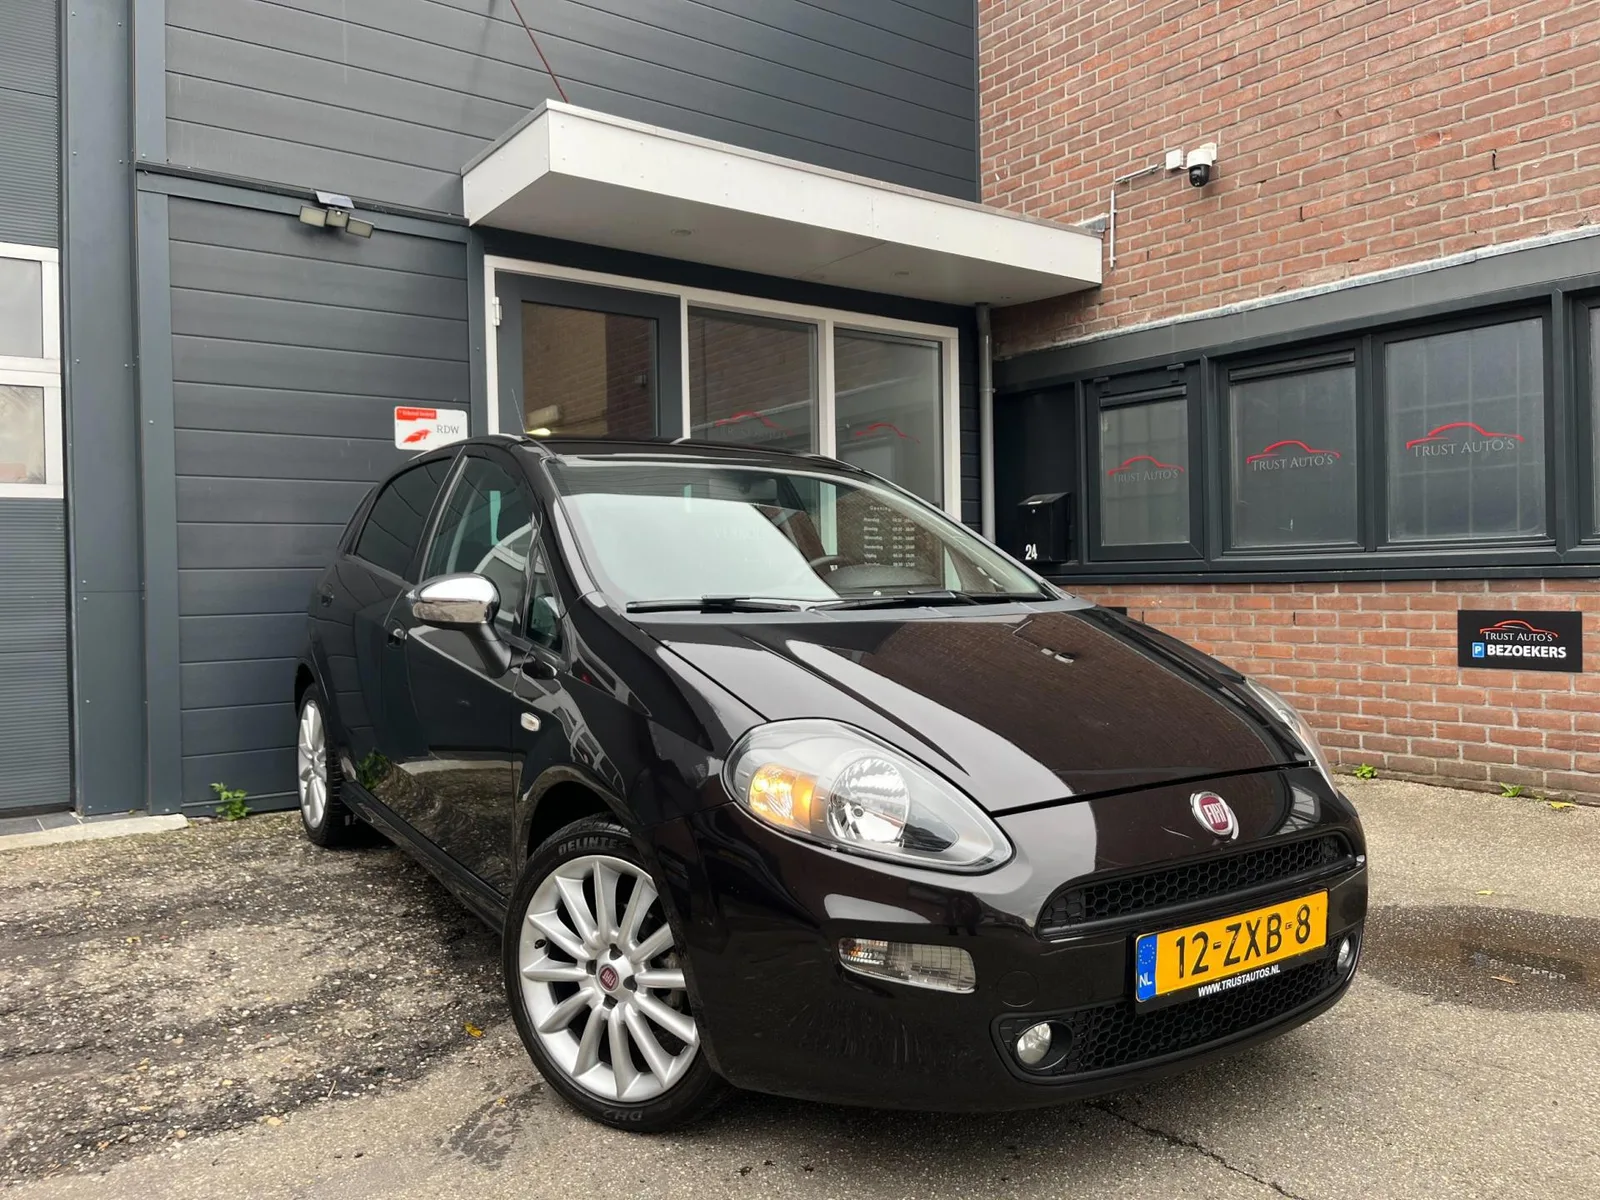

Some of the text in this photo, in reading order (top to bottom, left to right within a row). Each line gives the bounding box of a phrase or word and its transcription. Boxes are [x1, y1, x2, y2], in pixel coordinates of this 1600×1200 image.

[436, 424, 460, 434] RDW
[1413, 437, 1515, 458] TRUST AUTO'S
[1251, 453, 1334, 472] TRUST AUTO'S
[1025, 543, 1038, 560] 24
[1484, 630, 1553, 642] TRUST AUTO'S
[1487, 644, 1567, 658] BEZOEKERS
[1203, 803, 1227, 824] FIAT
[1175, 904, 1311, 980] 12-ZXB-8
[1139, 972, 1153, 988] NL
[1198, 963, 1281, 998] WWW.TRUSTAUTOS.NL
